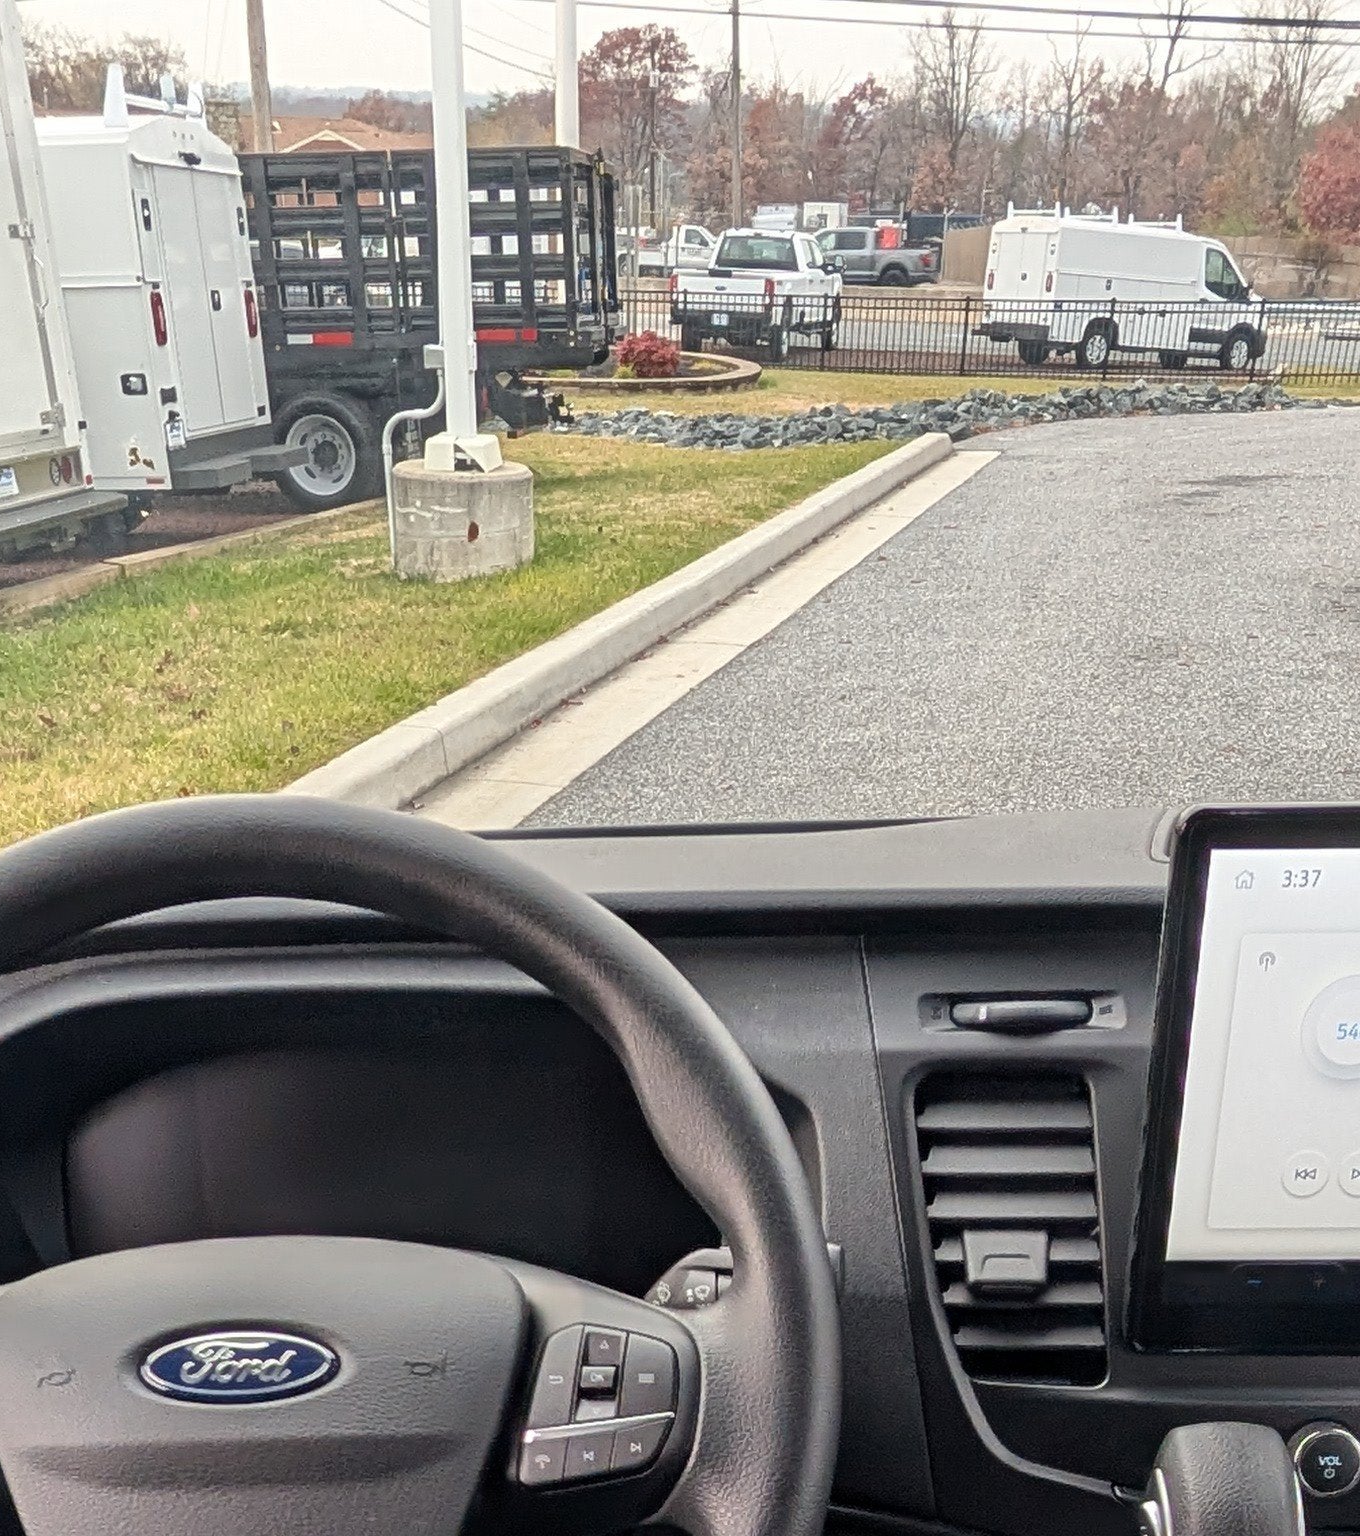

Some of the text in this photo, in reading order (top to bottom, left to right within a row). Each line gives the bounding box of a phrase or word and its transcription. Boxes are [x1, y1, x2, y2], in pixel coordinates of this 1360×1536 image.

[1281, 869, 1322, 888] 3:37
[180, 1340, 298, 1385] Ford
[1318, 1456, 1343, 1467] VOL
